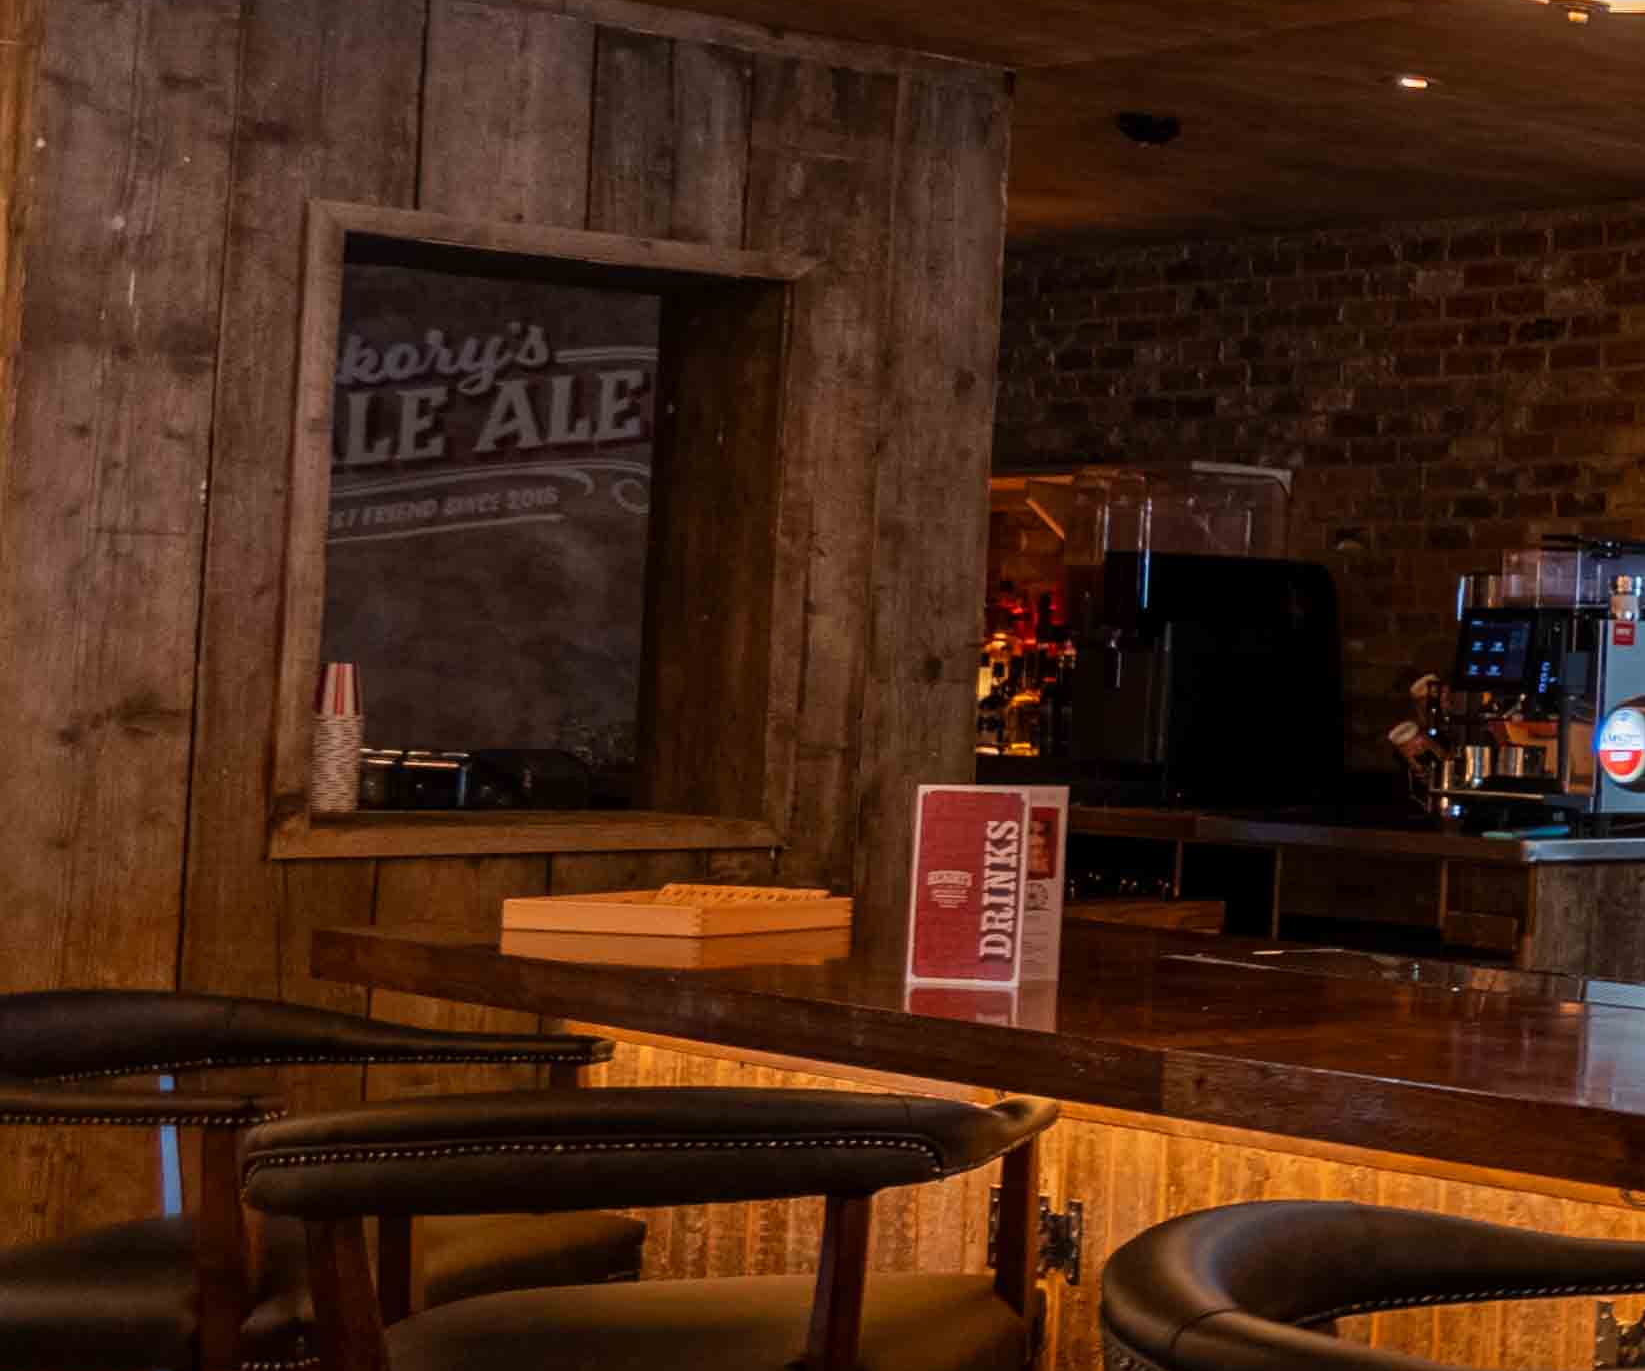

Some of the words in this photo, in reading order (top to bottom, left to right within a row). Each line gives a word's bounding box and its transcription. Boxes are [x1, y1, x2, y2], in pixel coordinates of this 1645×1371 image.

[334, 321, 551, 397] kory's
[332, 385, 449, 466] LE
[472, 369, 645, 453] ALE
[978, 820, 1020, 959] DRINKS
